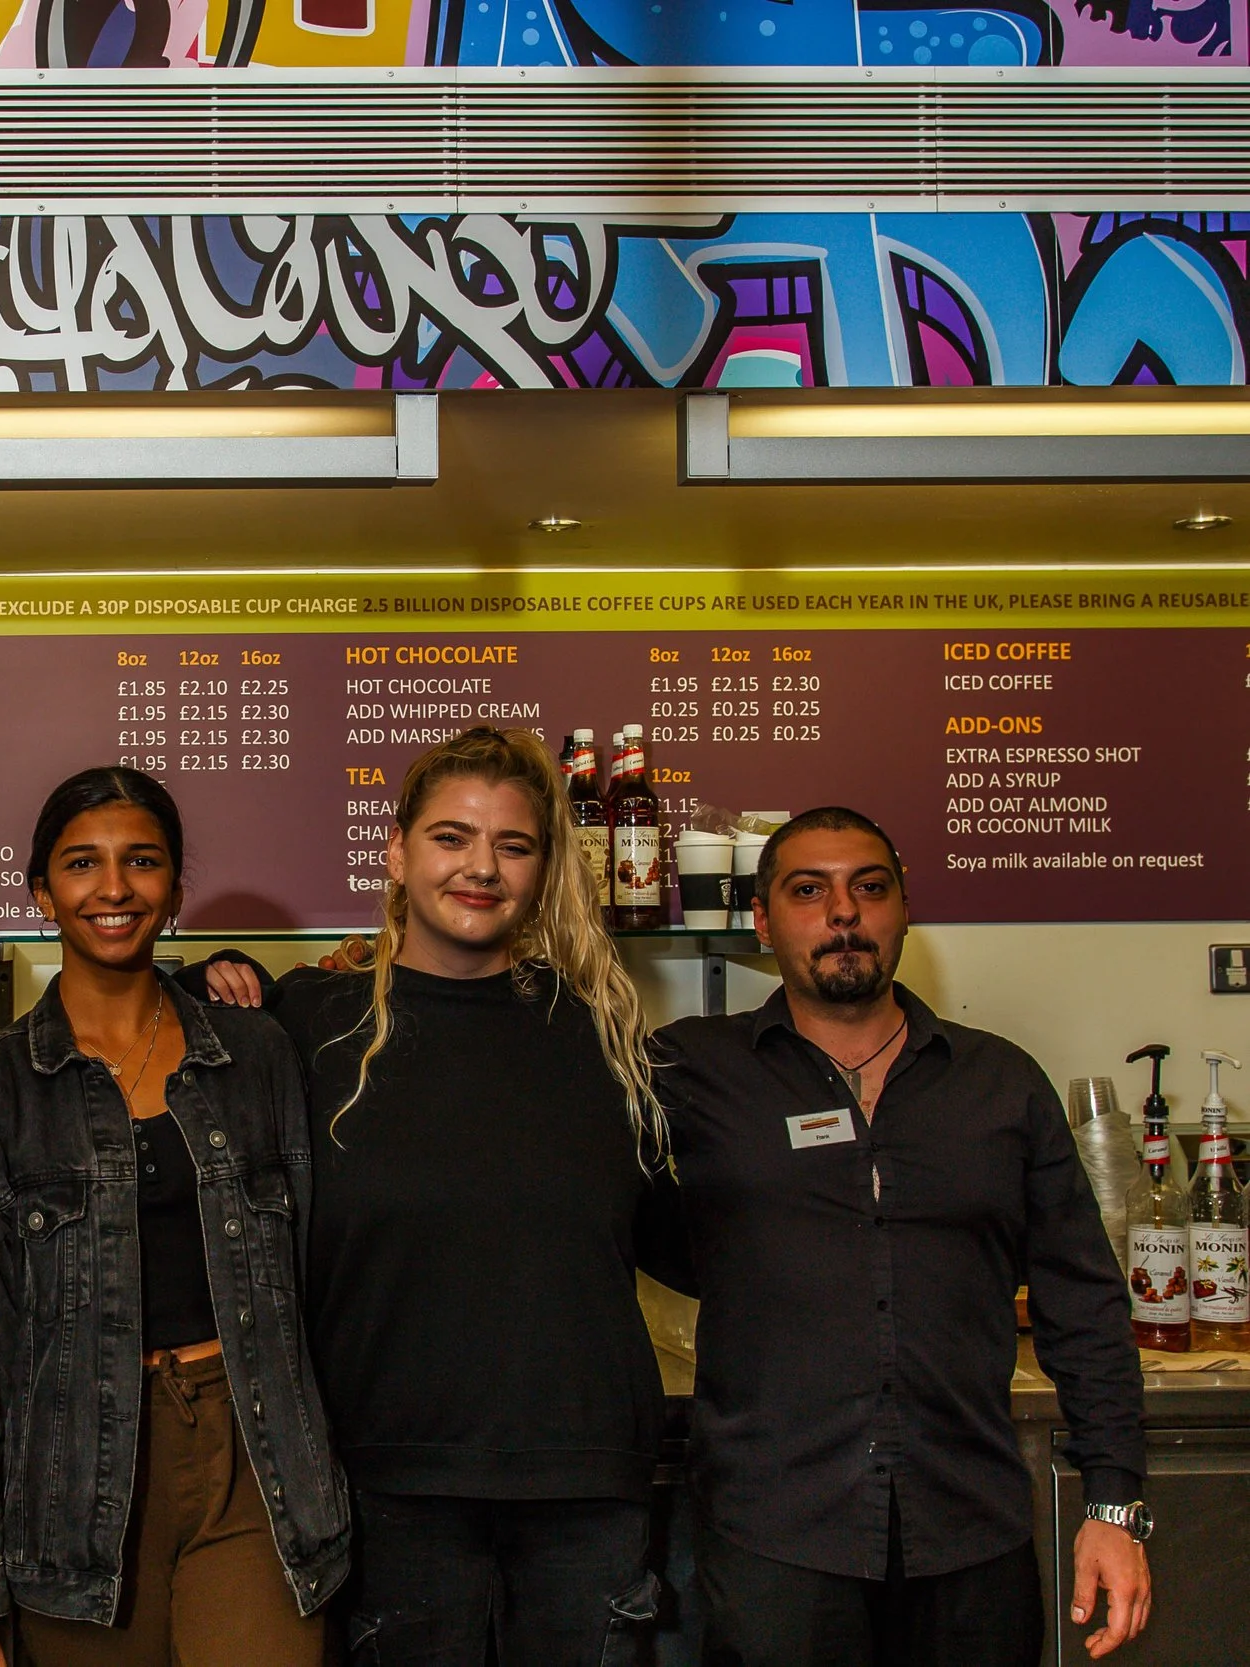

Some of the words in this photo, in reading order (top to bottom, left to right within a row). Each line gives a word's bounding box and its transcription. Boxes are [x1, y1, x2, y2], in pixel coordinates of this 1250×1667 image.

[79, 600, 93, 615] A
[97, 599, 130, 615] 30P
[134, 599, 241, 615] DISPOSABLE
[245, 598, 282, 614] CUP
[286, 598, 358, 613] CHARGE
[362, 598, 389, 613] 2.5
[394, 597, 465, 613] BILLION
[470, 596, 582, 612] DISPOSABLE
[587, 596, 654, 612] COFFEE
[659, 595, 706, 611] CUPS
[711, 595, 747, 611] ARE
[752, 595, 800, 610] USED
[805, 595, 852, 610] EACH
[857, 594, 904, 610] YEAR
[909, 594, 929, 609] IN
[933, 594, 968, 609] THE
[973, 594, 1004, 612] UK,
[1009, 593, 1073, 609] PLEASE
[1078, 593, 1135, 609] BRING
[1140, 593, 1154, 608] A
[1158, 592, 1249, 608] REUSABLE
[117, 651, 148, 667] 8oz
[179, 650, 219, 666] 12oz
[241, 650, 281, 665] 16oz
[346, 646, 390, 665] HOT
[395, 646, 518, 664] CHOCOLATE
[649, 647, 680, 663] 8oz
[711, 647, 751, 662] 12oz
[772, 646, 812, 662] 16oz
[944, 642, 991, 661] ICED
[996, 642, 1071, 661] COFFEE
[117, 680, 166, 697] £1.85
[179, 680, 228, 696] £2.10
[240, 679, 289, 695] £2.25
[346, 679, 384, 695] HOT
[388, 678, 492, 694] CHOCOLATE
[650, 676, 698, 693] £1.95
[711, 676, 759, 692] £2.15
[772, 675, 820, 692] £2.30
[944, 675, 984, 691] ICED
[988, 674, 1053, 691] COFFEE
[117, 705, 166, 721] £1.95
[179, 705, 228, 721] £2.15
[240, 704, 290, 720] £2.30
[346, 704, 385, 720] ADD
[389, 703, 472, 719] WHIPPED
[477, 702, 540, 719] CREAM
[650, 701, 699, 718] £0.25
[711, 701, 760, 717] £0.25
[772, 700, 820, 717] £0.25
[945, 716, 1043, 735] ADD-ONS
[118, 730, 167, 746] £1.95
[179, 729, 228, 746] £2.15
[241, 729, 290, 745] £2.30
[346, 729, 385, 744] ADD
[391, 728, 545, 744] MARSHS
[651, 726, 699, 742] £0.25
[712, 725, 760, 742] £0.25
[773, 725, 821, 741] £0.25
[118, 755, 167, 771] £1.95
[179, 754, 228, 771] £2.15
[241, 754, 290, 770] £2.30
[946, 748, 1001, 764] EXTRA
[1006, 747, 1090, 764] ESPRESSO
[1095, 747, 1142, 763] SHOT
[345, 767, 386, 786] TEA
[652, 767, 691, 783] 12oz
[945, 772, 984, 789] ADD
[988, 772, 1002, 788] A
[1005, 772, 1061, 788] SYRUP
[946, 797, 985, 813] ADD
[989, 797, 1025, 813] OAT
[1028, 796, 1108, 813] ALMOND
[347, 825, 388, 841] CHAI
[946, 818, 972, 834] OR
[976, 817, 1065, 834] COCONUT
[1069, 817, 1112, 833] MILK
[581, 838, 609, 848] ONIN
[947, 853, 987, 873] Soya
[992, 852, 1028, 869] milk
[1032, 851, 1107, 869] available
[1112, 855, 1134, 868] on
[1139, 852, 1204, 871] request
[1133, 1241, 1185, 1254] MONIN
[1195, 1240, 1246, 1253] MONIN
